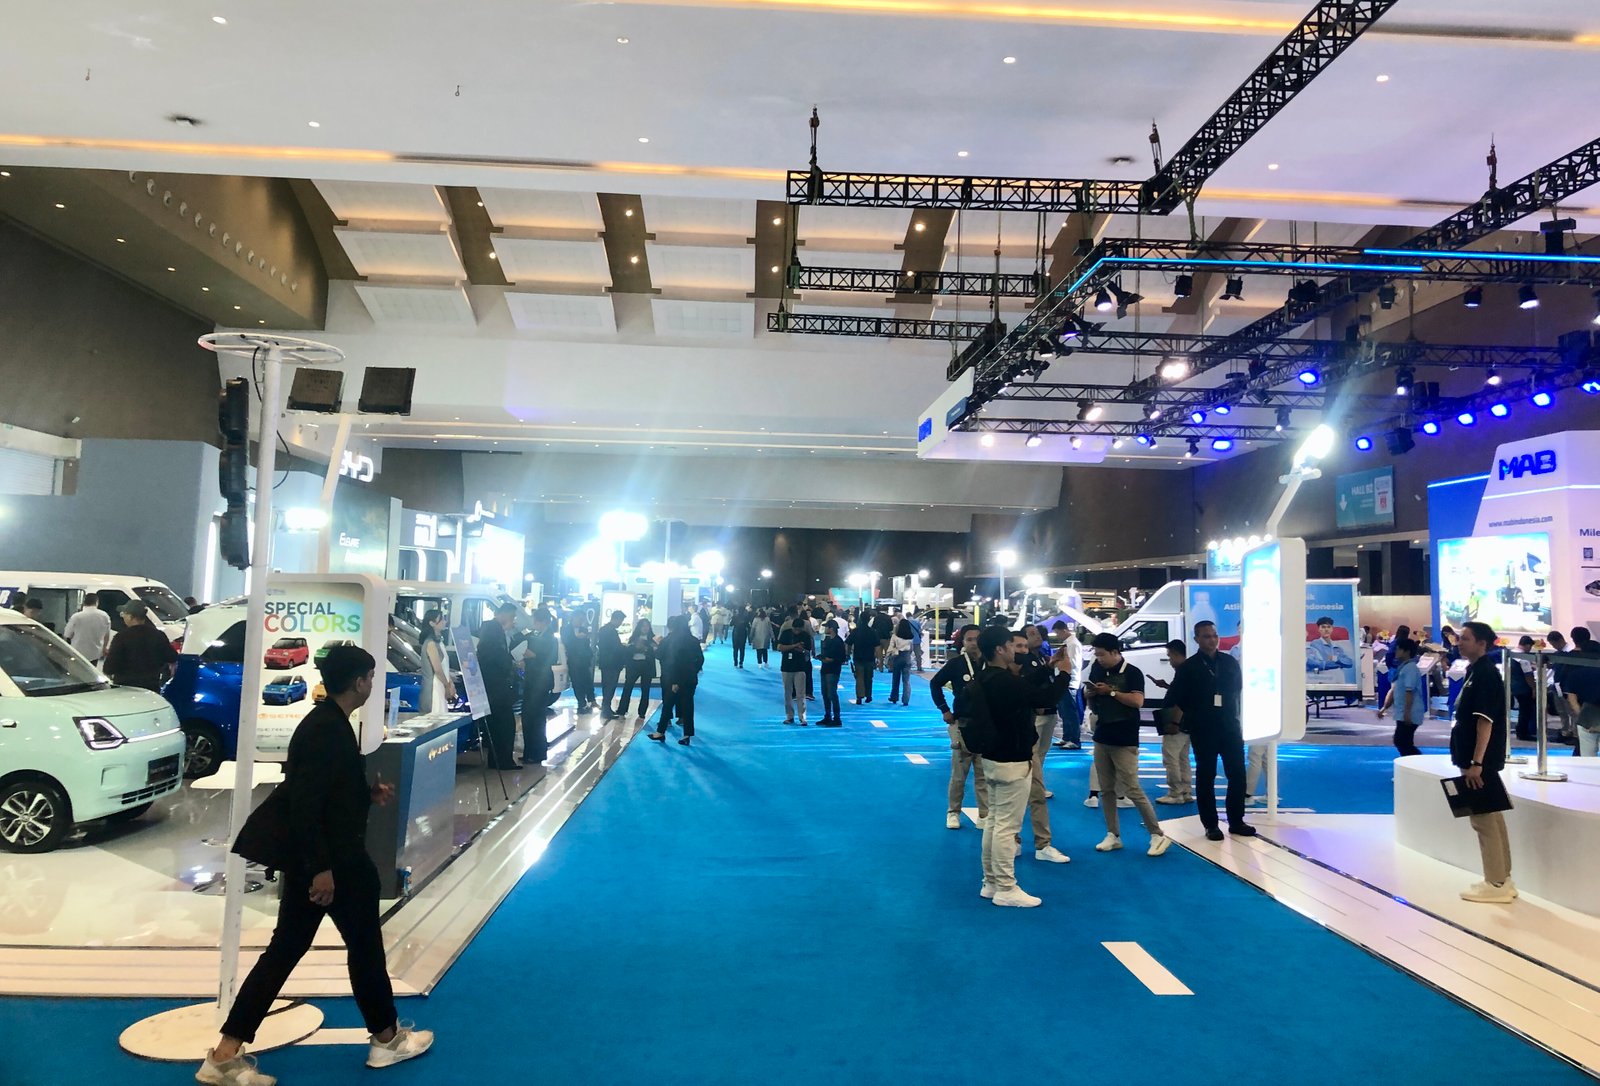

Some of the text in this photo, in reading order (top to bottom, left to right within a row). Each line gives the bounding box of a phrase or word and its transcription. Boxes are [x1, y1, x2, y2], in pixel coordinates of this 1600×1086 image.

[1499, 450, 1557, 481] MAB
[1351, 485, 1366, 496] HALL
[264, 602, 336, 615] SPECIAL
[1305, 602, 1344, 610] ndonesia
[264, 614, 361, 632] COLORS
